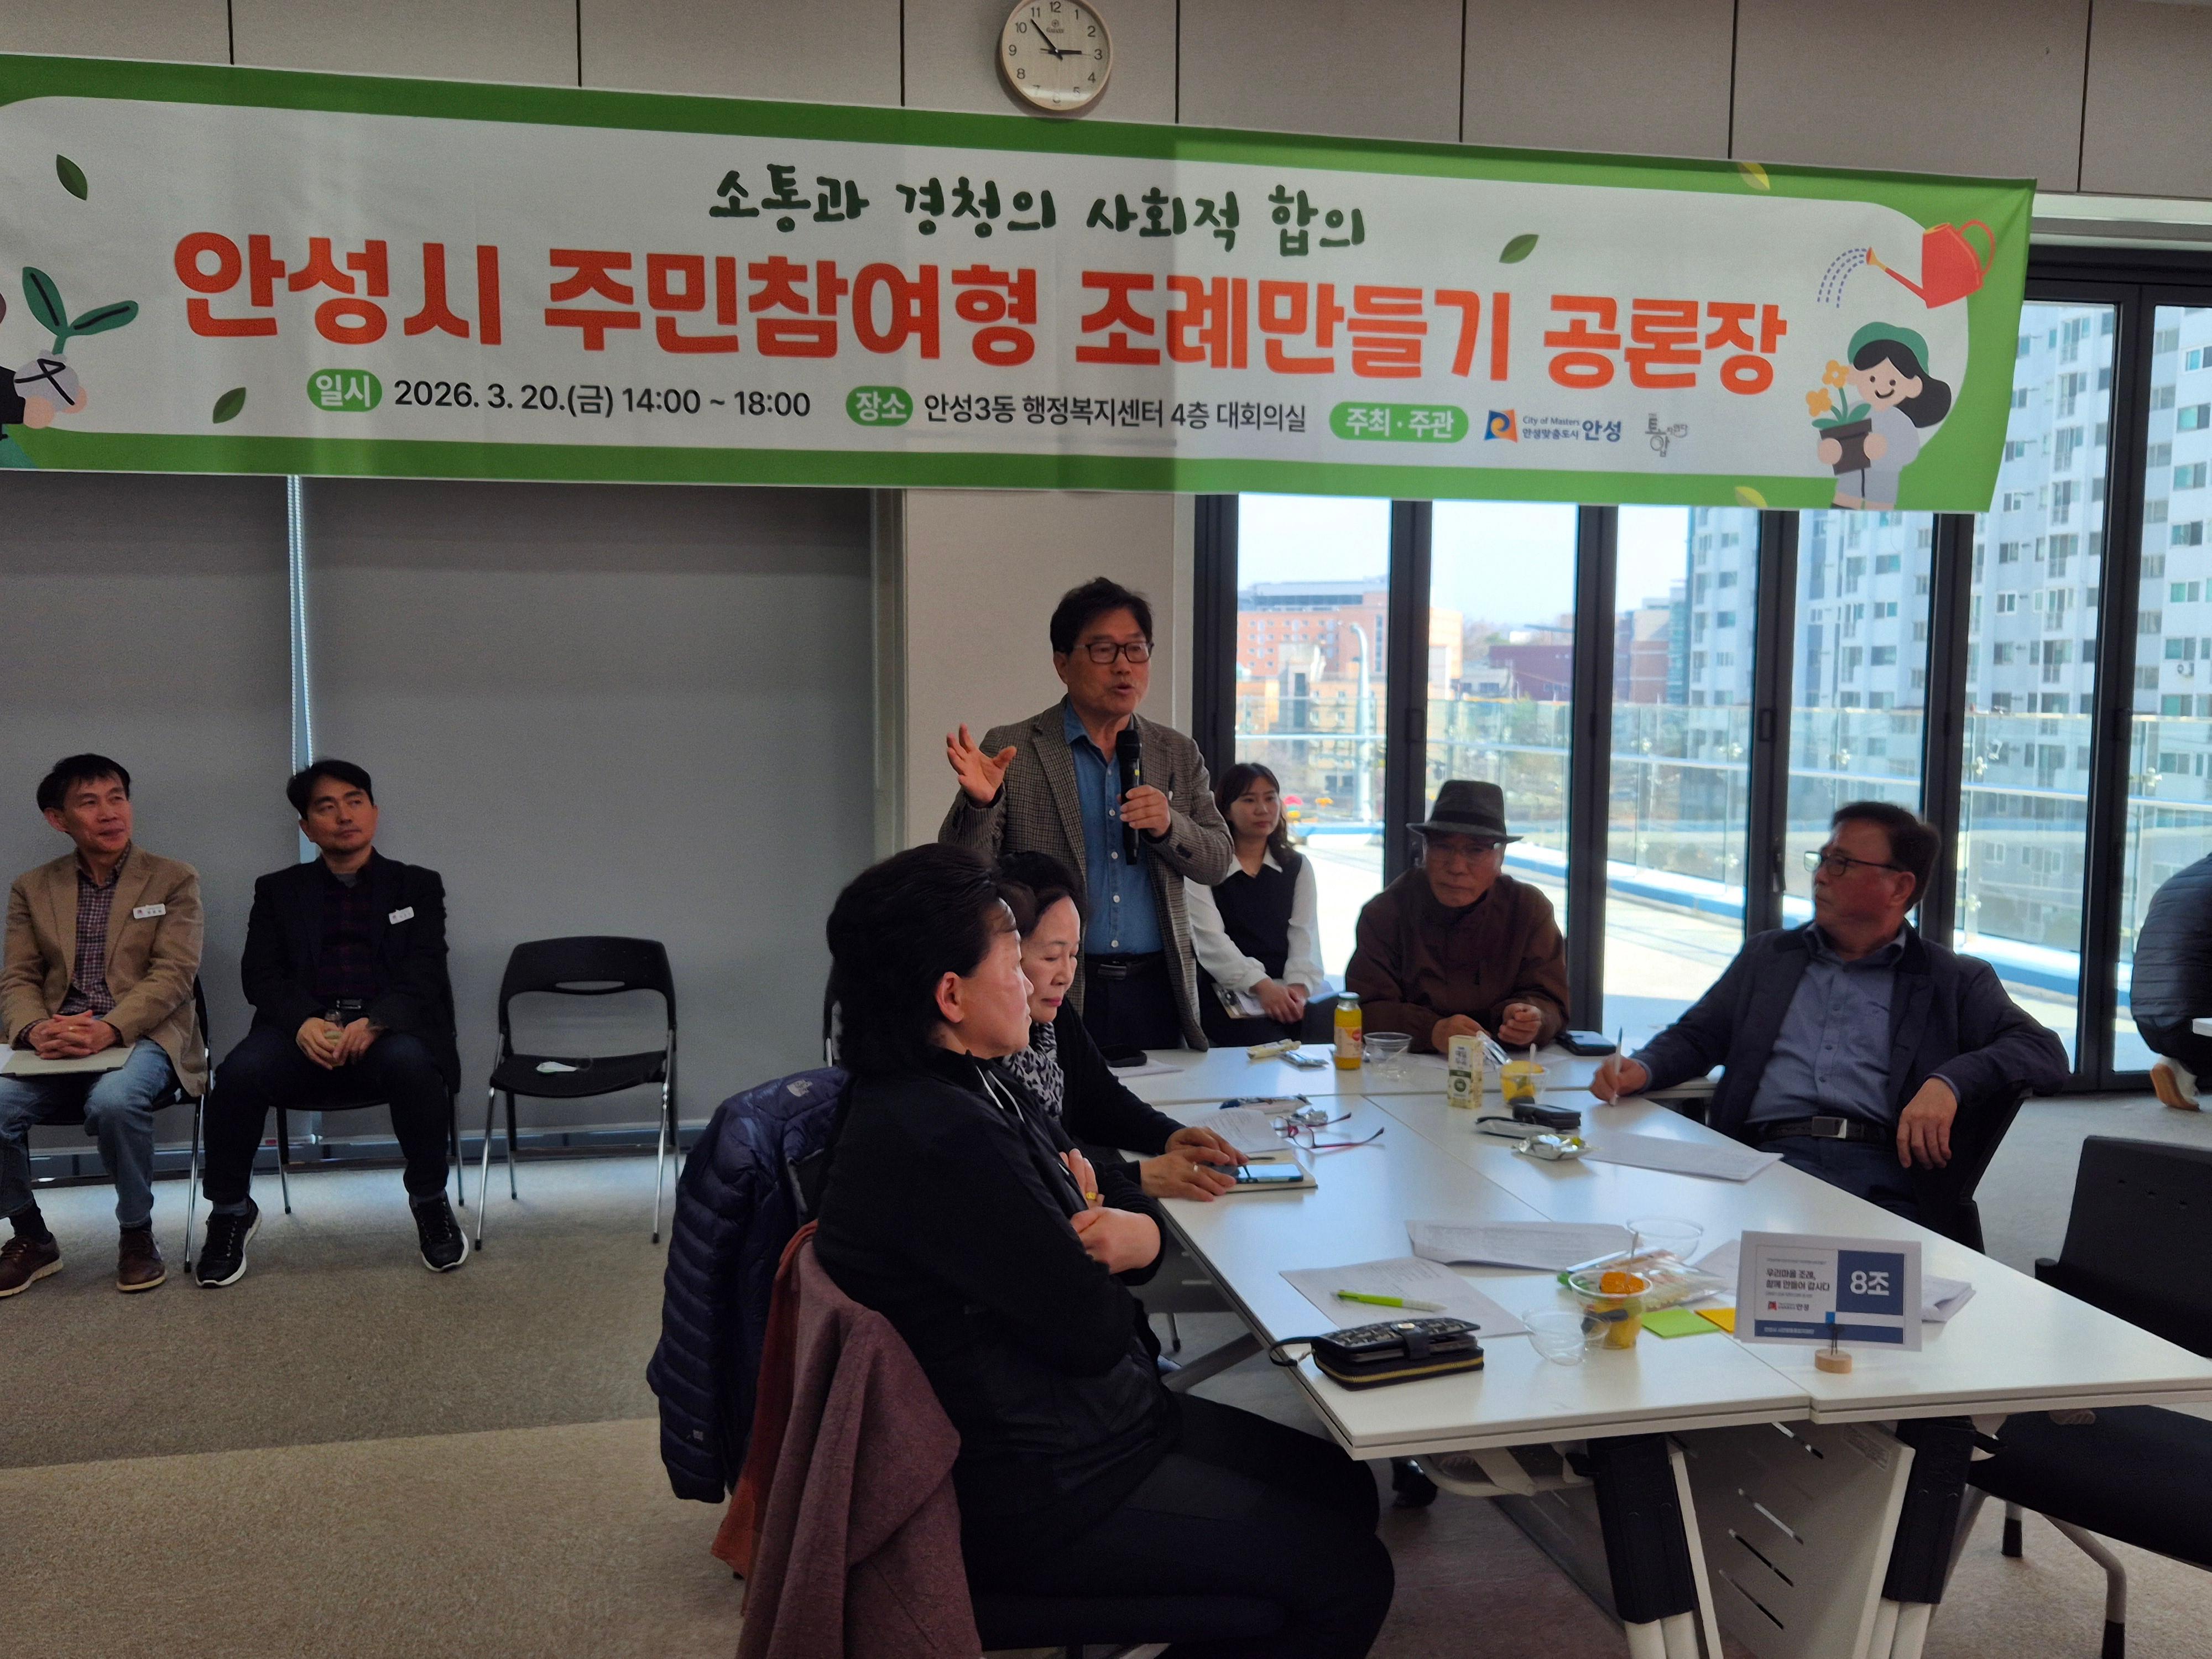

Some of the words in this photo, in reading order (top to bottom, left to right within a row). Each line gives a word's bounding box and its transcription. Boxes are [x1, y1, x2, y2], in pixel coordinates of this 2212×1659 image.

[1031, 7, 1040, 18] 11
[1050, 1, 1061, 13] 12
[1075, 9, 1078, 20] 1
[1015, 22, 1027, 33] 10
[1087, 25, 1096, 37] 2
[1009, 44, 1017, 56] 9
[1094, 49, 1102, 60] 3
[1016, 68, 1025, 79] 8
[1088, 72, 1096, 83] 4
[709, 164, 869, 232] 소통과
[896, 176, 1056, 238] 경청의
[1087, 187, 1239, 252] 사회적
[1269, 185, 1364, 256] 합의
[174, 232, 502, 346] 안성시
[545, 249, 1037, 367] 주민참여형
[1076, 272, 1510, 381] 조례만들기
[1545, 295, 1788, 395] 공론장
[316, 374, 371, 408] 일시
[394, 380, 479, 408] 2026.
[488, 383, 513, 409] 3.
[521, 384, 613, 418] 20.(금)
[623, 388, 701, 414] 14:00
[734, 391, 811, 417] 18:00
[856, 392, 908, 421] 장소
[924, 393, 1016, 424] 안성3동
[1022, 395, 1163, 429] 행정복지센터
[1171, 401, 1209, 429] 4층
[1217, 401, 1305, 432] 대회의실
[1345, 407, 1390, 437] 주최
[1408, 409, 1455, 440] 주관
[1522, 416, 1537, 426] City
[1550, 418, 1580, 426] Masters
[1581, 420, 1622, 443] 안성
[1850, 1270, 1889, 1296] 8조
